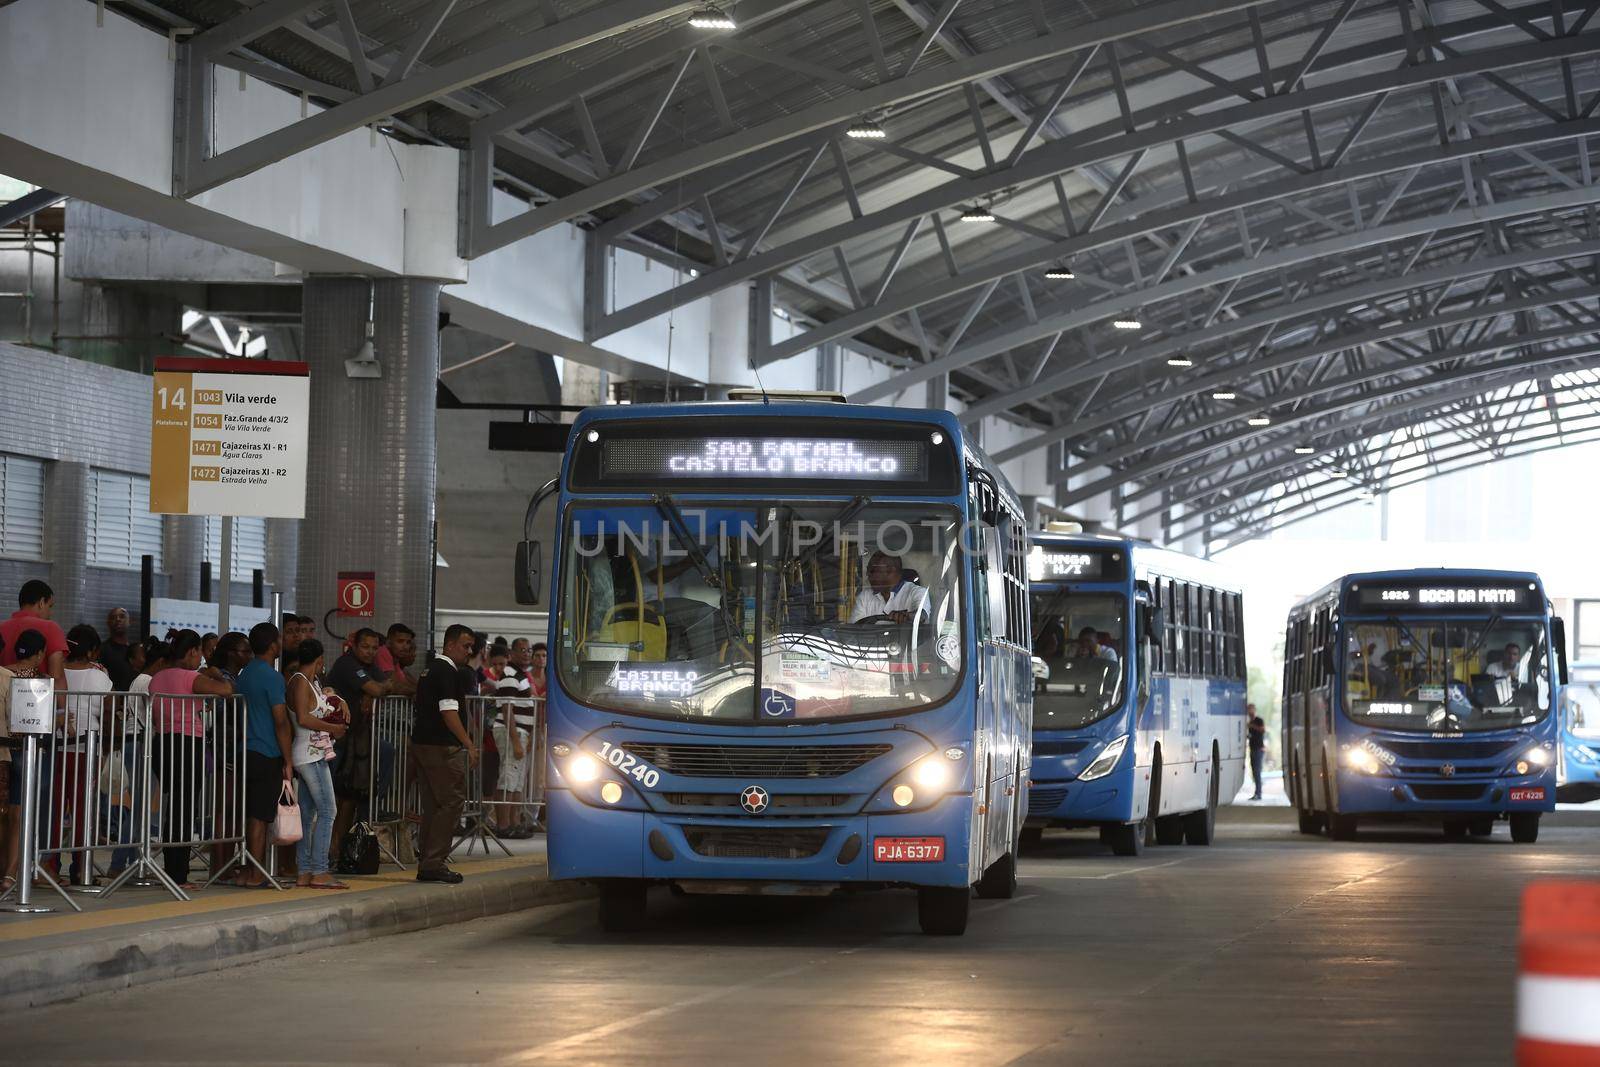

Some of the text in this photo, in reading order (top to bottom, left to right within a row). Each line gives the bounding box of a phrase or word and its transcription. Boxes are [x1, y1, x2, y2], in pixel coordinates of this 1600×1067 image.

[157, 387, 187, 410] 14
[197, 392, 221, 403] 1043
[225, 393, 277, 405] Vila verde
[195, 416, 218, 426] 1054
[224, 414, 289, 424] Faz.Grande 4/3/2
[237, 424, 250, 432] Vila
[252, 425, 272, 433] Verde
[194, 443, 217, 453] 1471
[221, 441, 261, 452] Cajazeiras
[263, 443, 271, 451] XI
[277, 443, 287, 451] R1
[763, 441, 863, 457] RAFAEL
[241, 451, 263, 460] Claras
[669, 456, 897, 473] CASTELO BRANCO
[193, 468, 216, 479] 1472
[220, 466, 260, 476] Cajazeiras
[261, 468, 270, 476] XI
[276, 468, 287, 476] R2
[221, 476, 268, 485] Estrada Velha
[1418, 589, 1455, 602] BOCA
[1457, 589, 1476, 602] DA
[1478, 589, 1516, 602] MATA
[616, 670, 698, 681] CASTELO
[597, 741, 660, 788] 10240
